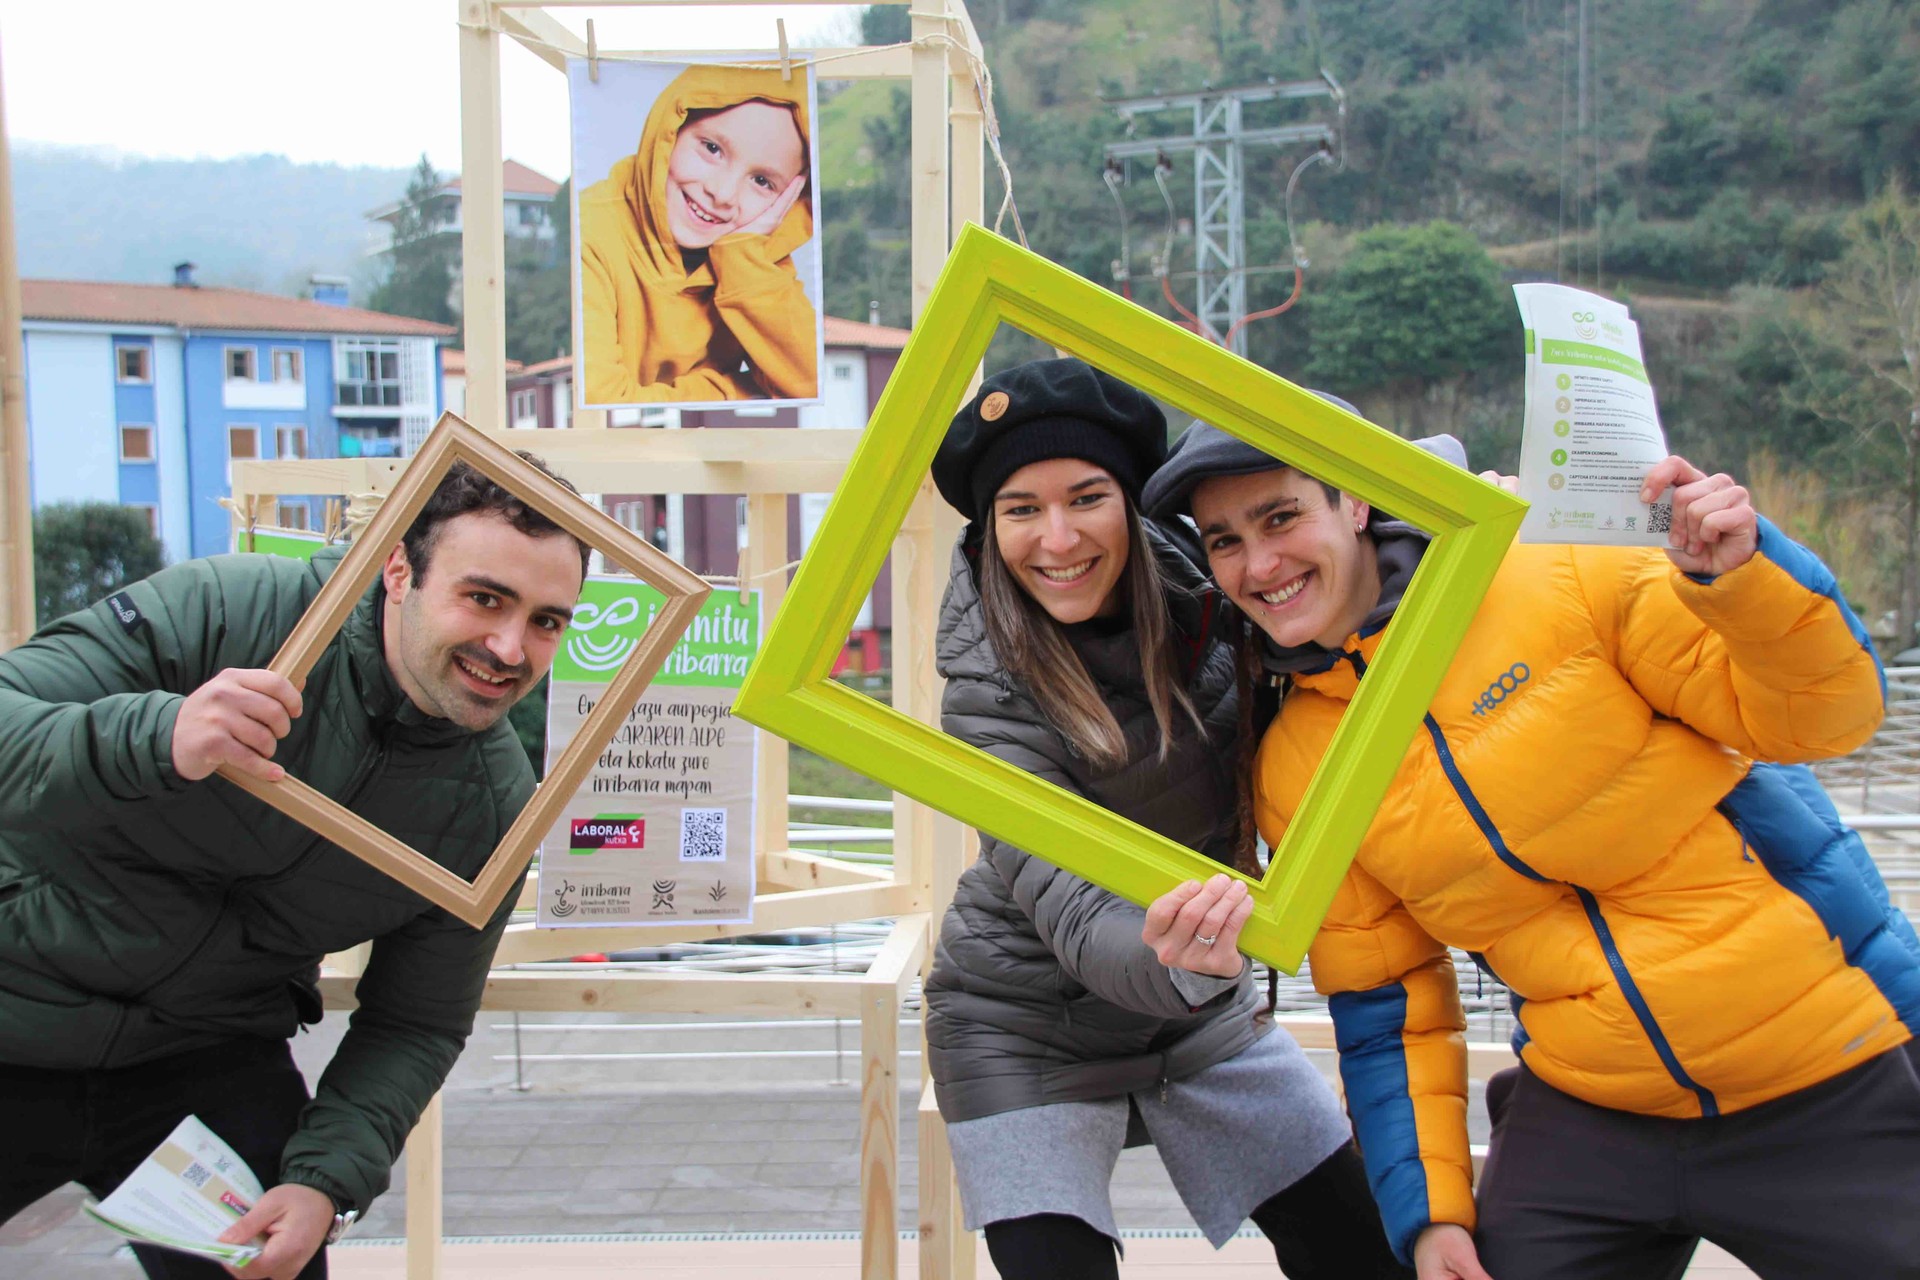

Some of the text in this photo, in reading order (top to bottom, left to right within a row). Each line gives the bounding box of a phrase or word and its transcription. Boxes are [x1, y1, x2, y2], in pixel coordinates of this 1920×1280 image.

[1555, 453, 1562, 461] 4
[598, 749, 709, 776] eta kokatu zure
[593, 774, 712, 799] irribarra mapan
[574, 825, 627, 836] LABORAL
[605, 836, 627, 844] kutxa
[581, 882, 631, 897] irribarra
